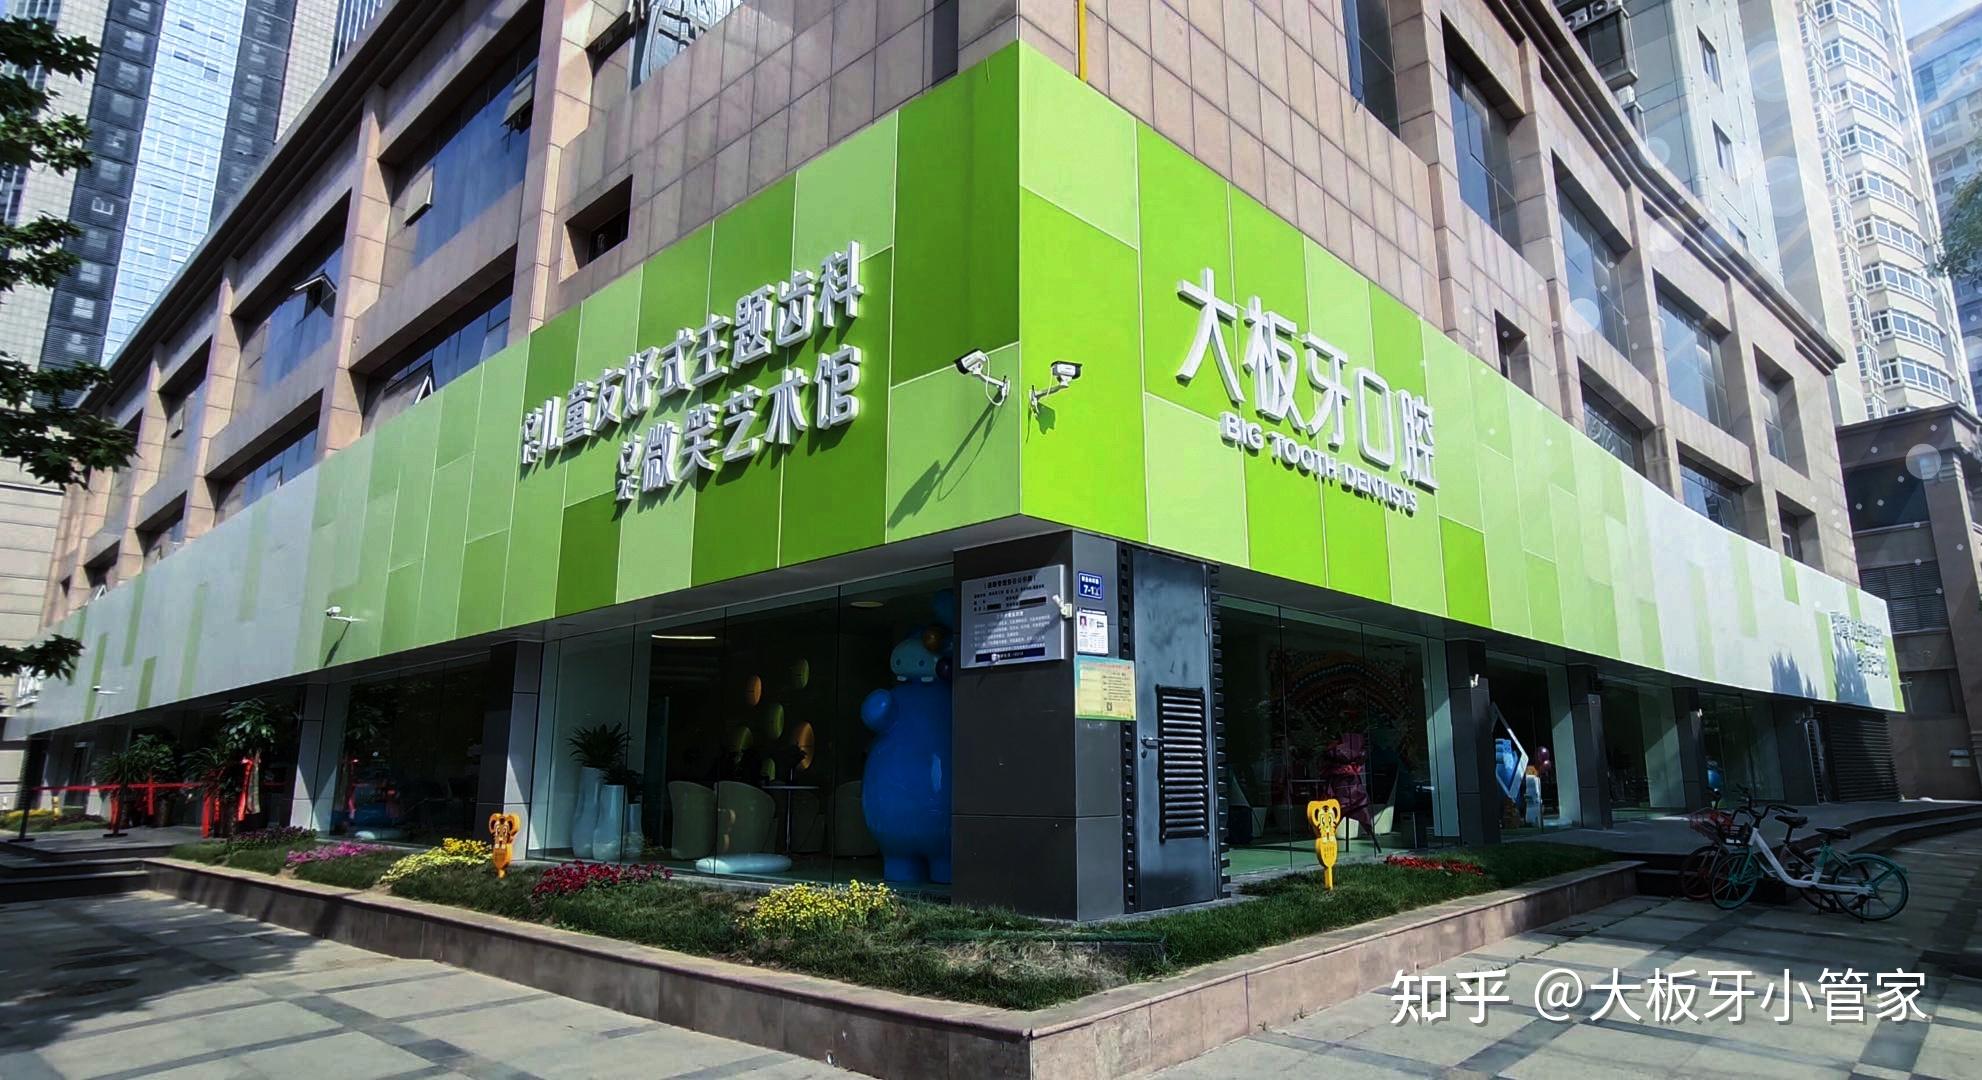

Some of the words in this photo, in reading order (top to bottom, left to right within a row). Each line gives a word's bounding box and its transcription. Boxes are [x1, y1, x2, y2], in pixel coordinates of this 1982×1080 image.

[641, 344, 863, 493] 微笑艺术馆
[1175, 266, 1440, 495] 大板牙口腔
[1219, 411, 1264, 451] BIG
[1267, 431, 1337, 481] TOOTH
[1341, 464, 1417, 514] DENTISTS
